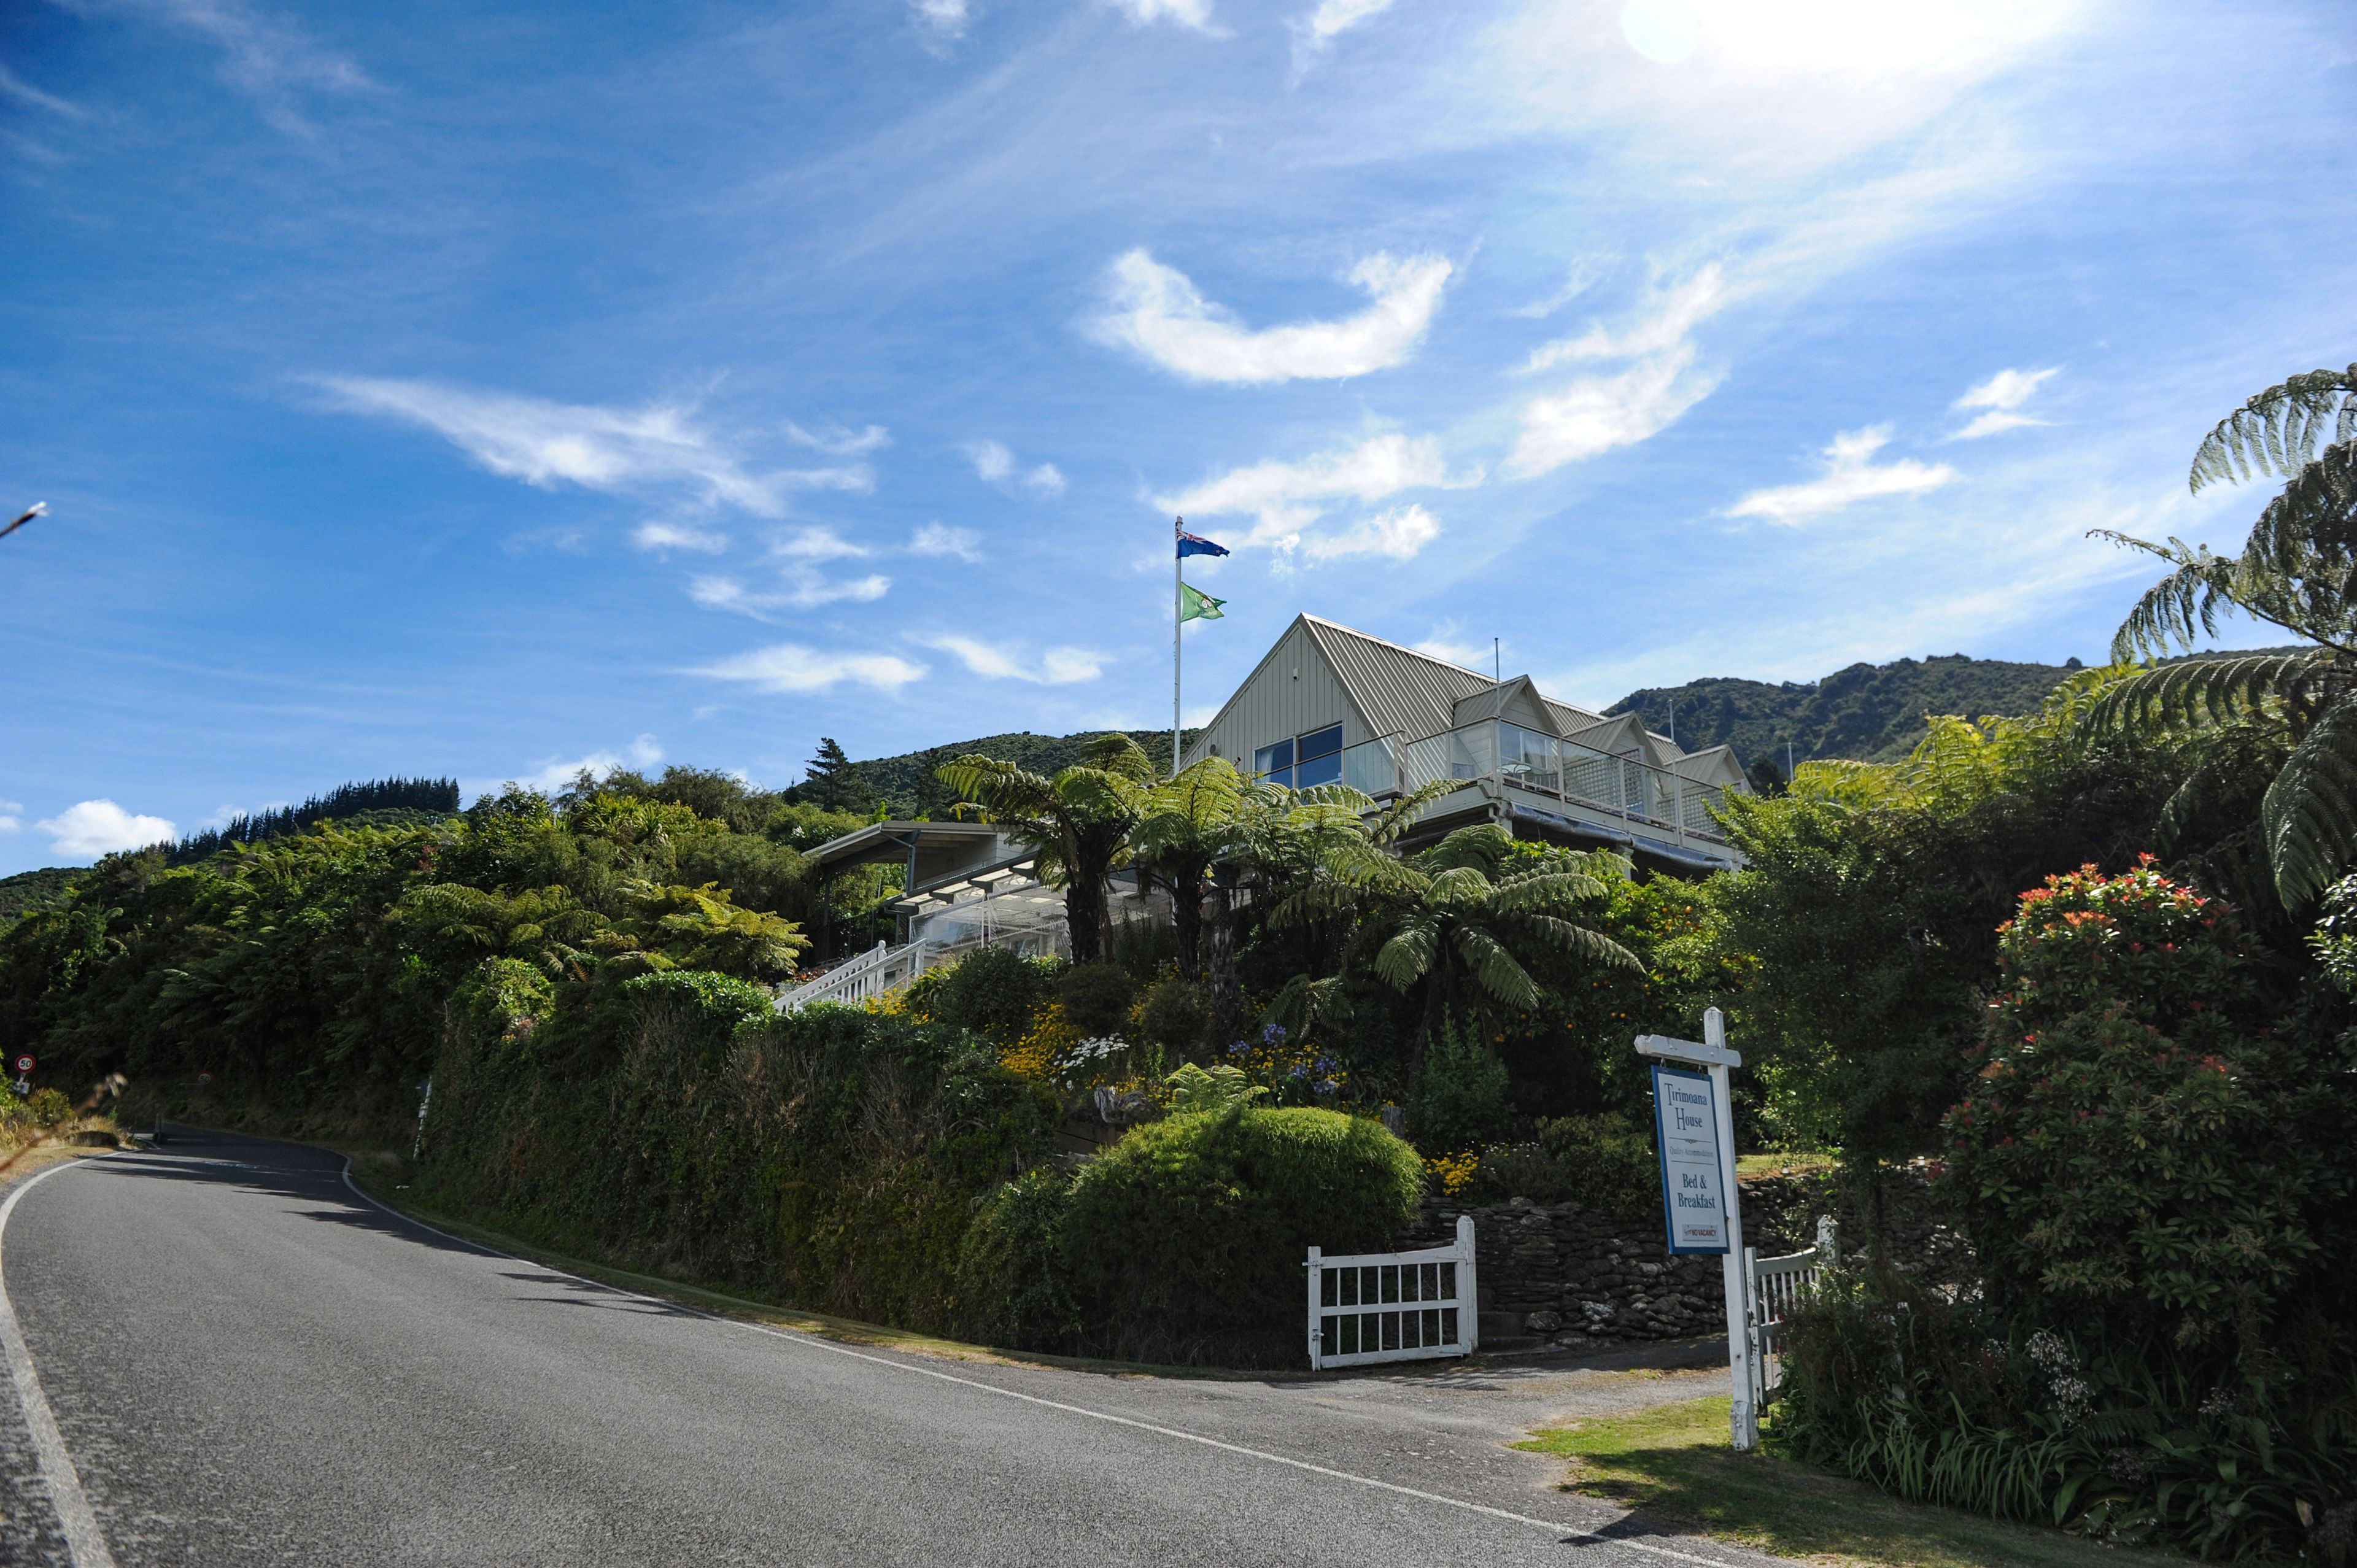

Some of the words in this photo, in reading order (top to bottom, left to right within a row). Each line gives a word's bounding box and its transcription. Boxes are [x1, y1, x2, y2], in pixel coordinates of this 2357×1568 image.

[1664, 1083, 1708, 1105] Tirimoana
[1675, 1107, 1703, 1130] House
[1682, 1173, 1698, 1189] Bed
[1700, 1175, 1707, 1189] &
[1678, 1192, 1716, 1208] Breakfast
